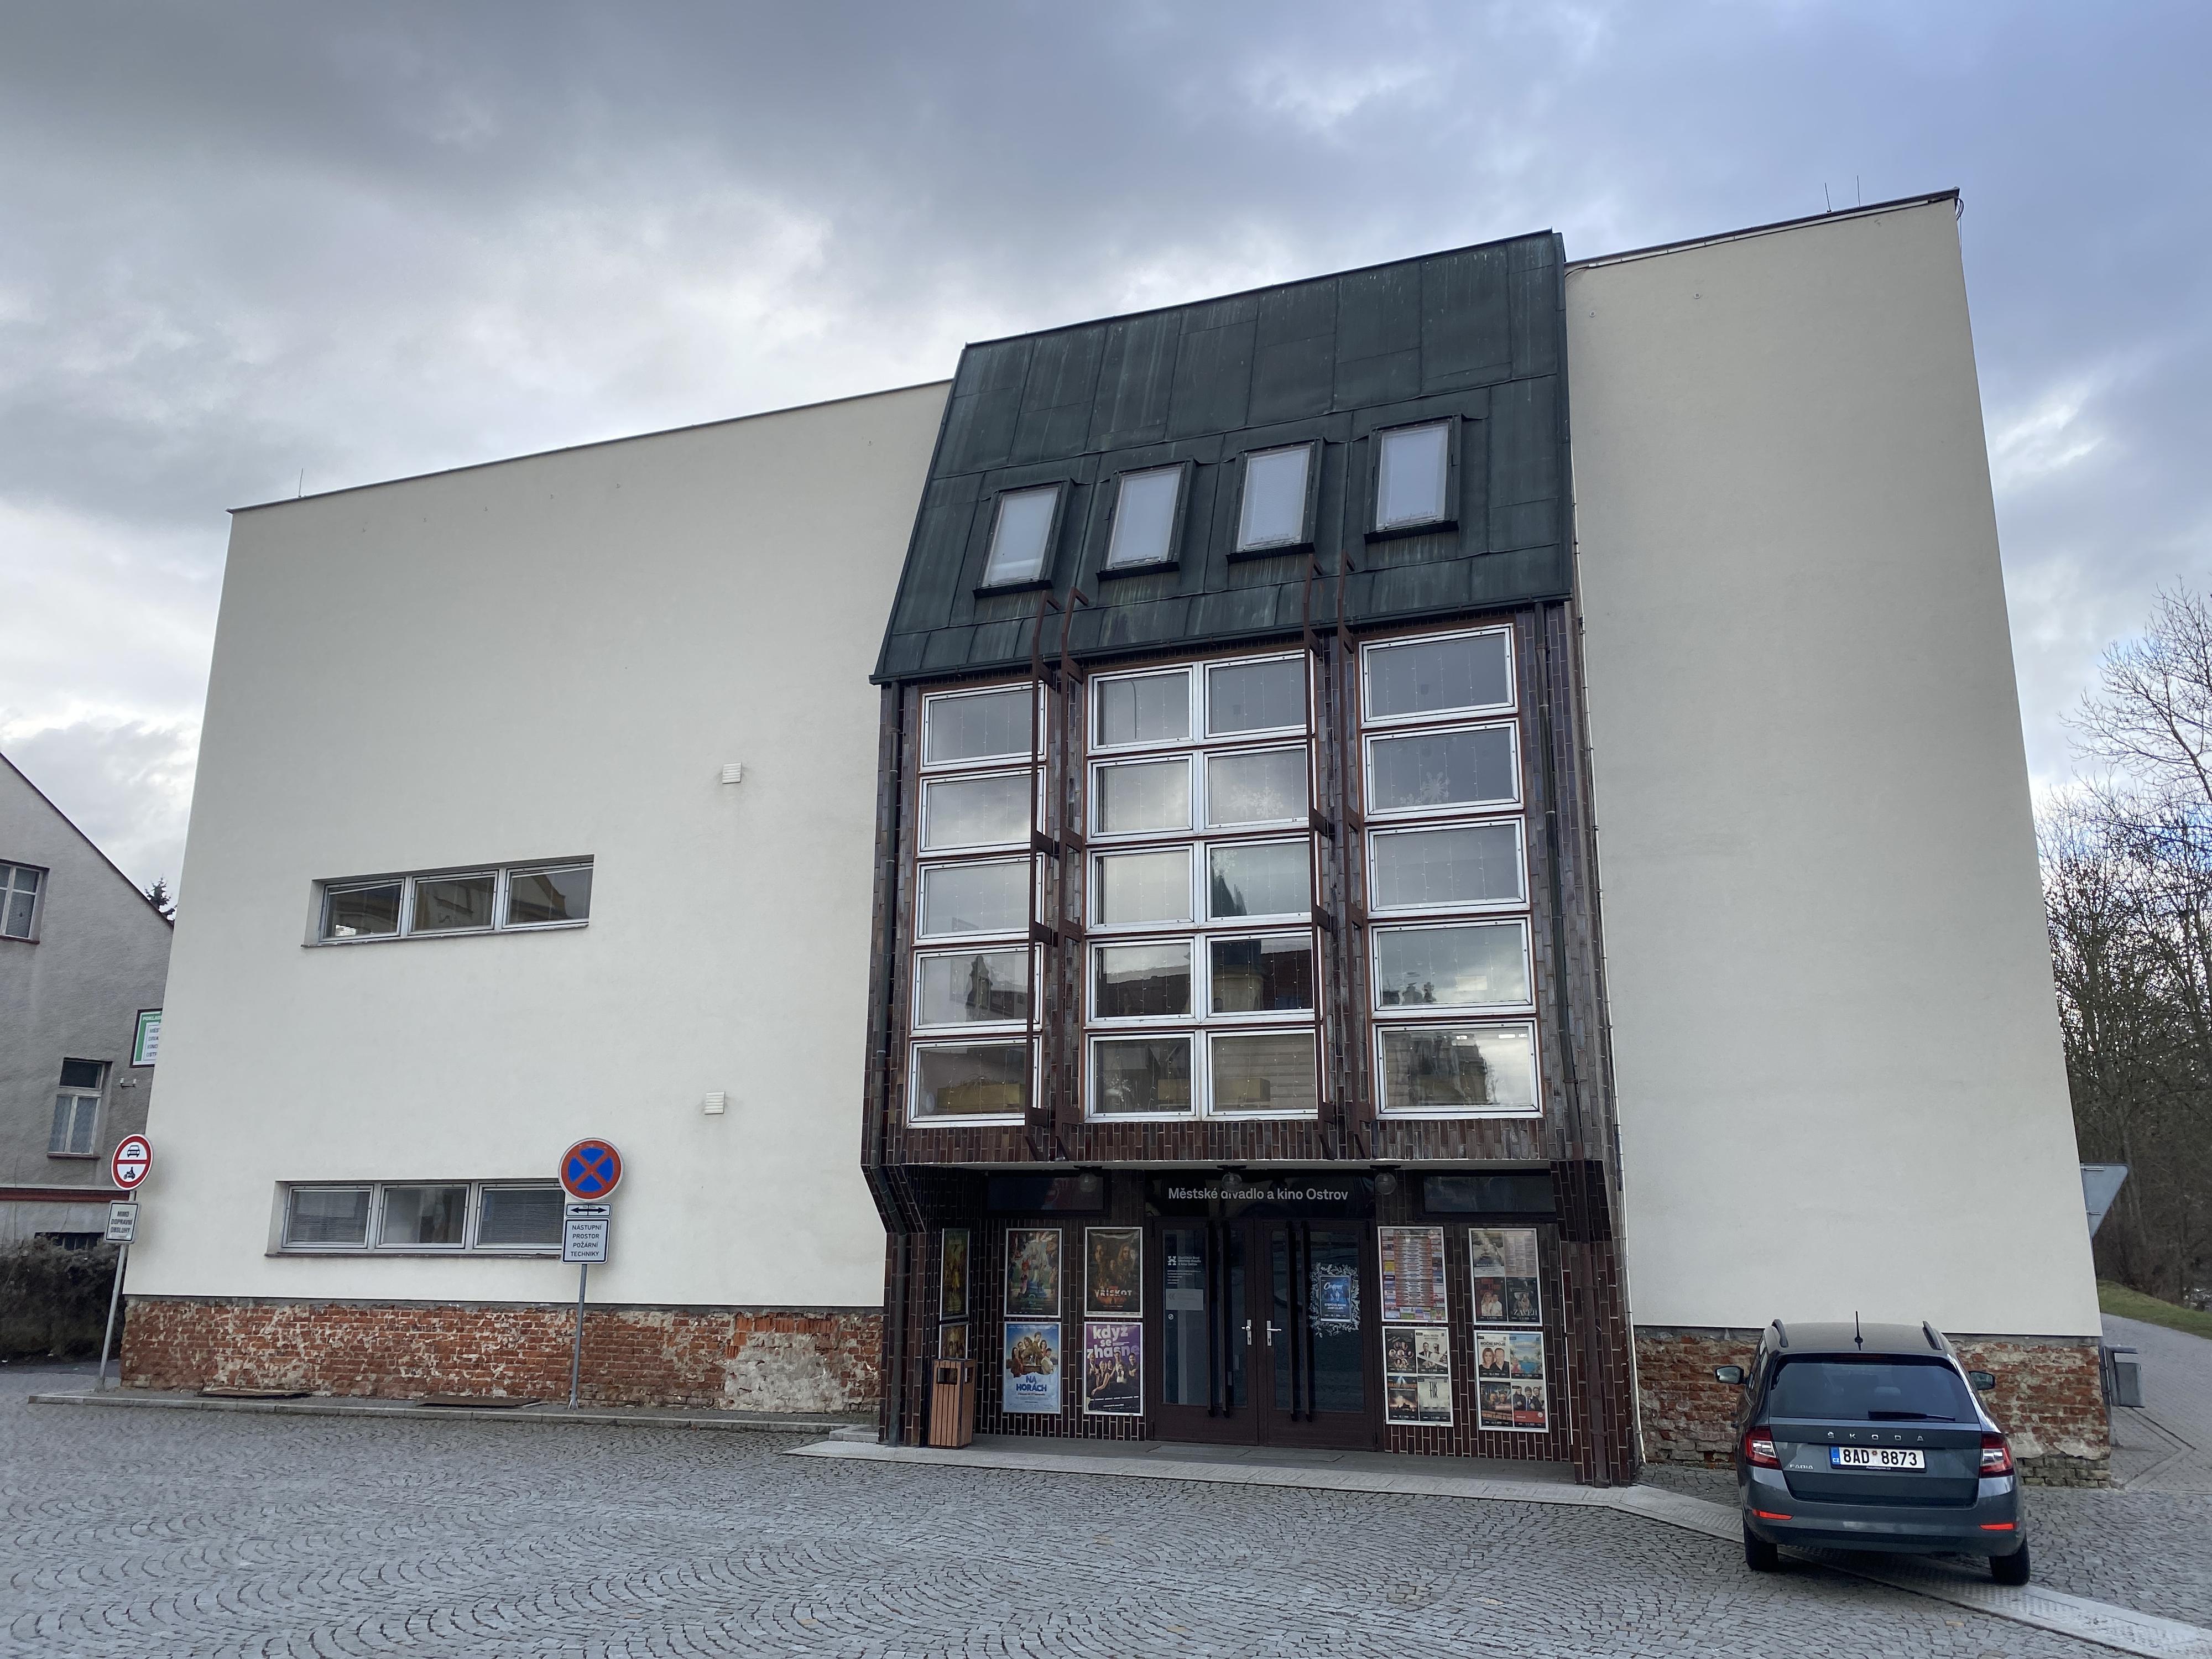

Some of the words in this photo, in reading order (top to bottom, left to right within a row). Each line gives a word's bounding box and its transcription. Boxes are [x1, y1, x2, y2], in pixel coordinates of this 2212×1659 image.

[1168, 1187, 1218, 1199] Městské
[1220, 1188, 1264, 1199] divadlo
[1266, 1191, 1275, 1199] a
[1277, 1188, 1303, 1200] kino
[1306, 1188, 1349, 1201] Ostrov
[1093, 1324, 1129, 1341] když
[1087, 1344, 1140, 1359] zhasne
[1016, 1383, 1047, 1392] HORÁCH
[1827, 1431, 1924, 1441] ŠKODA
[1843, 1448, 1870, 1464] 8AD
[1881, 1450, 1917, 1466] 8873
